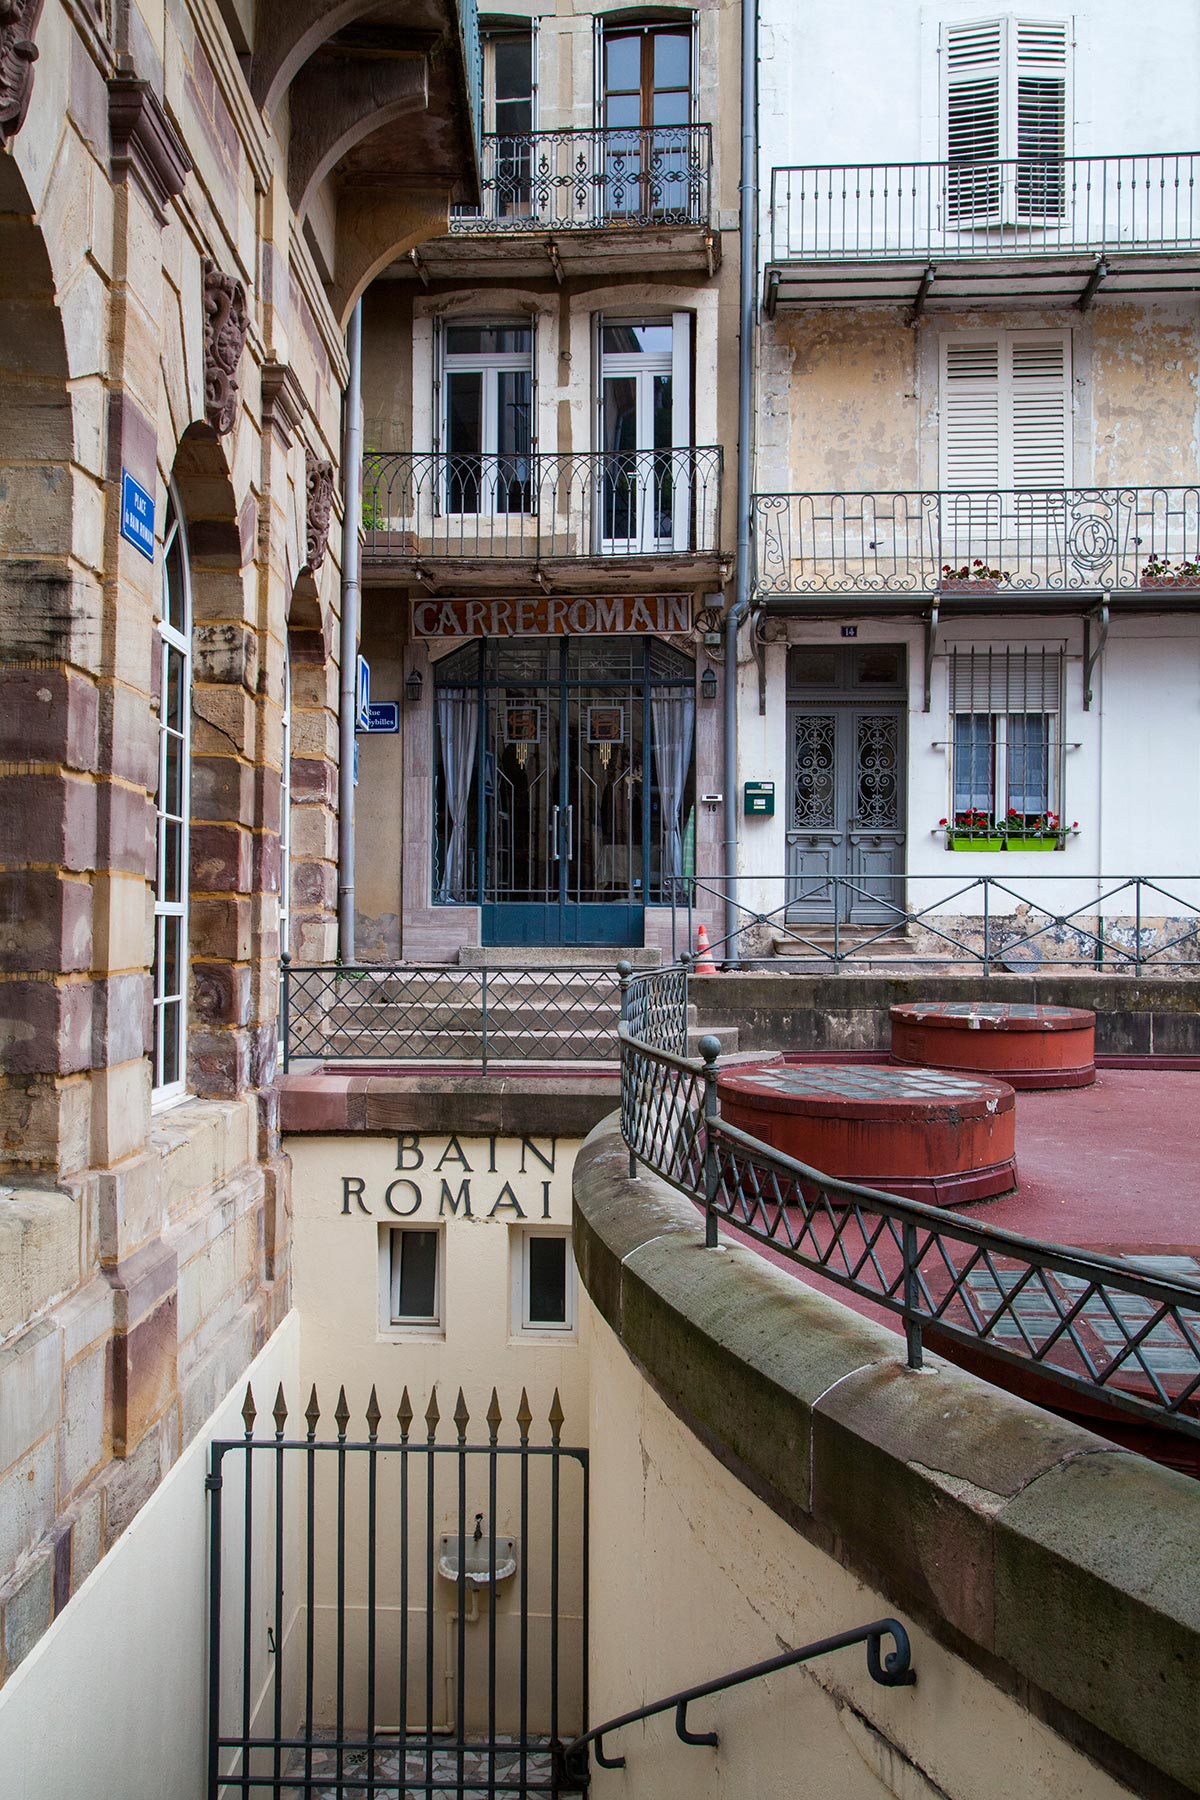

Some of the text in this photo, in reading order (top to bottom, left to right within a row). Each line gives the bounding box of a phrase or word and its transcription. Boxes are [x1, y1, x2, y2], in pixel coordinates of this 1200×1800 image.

[134, 492, 147, 517] PLACE
[129, 511, 140, 534] BAIN
[140, 521, 153, 548] ROMAIN
[707, 804, 717, 812] 16
[395, 1133, 556, 1174] BAIN
[340, 1176, 553, 1219] ROMAI
